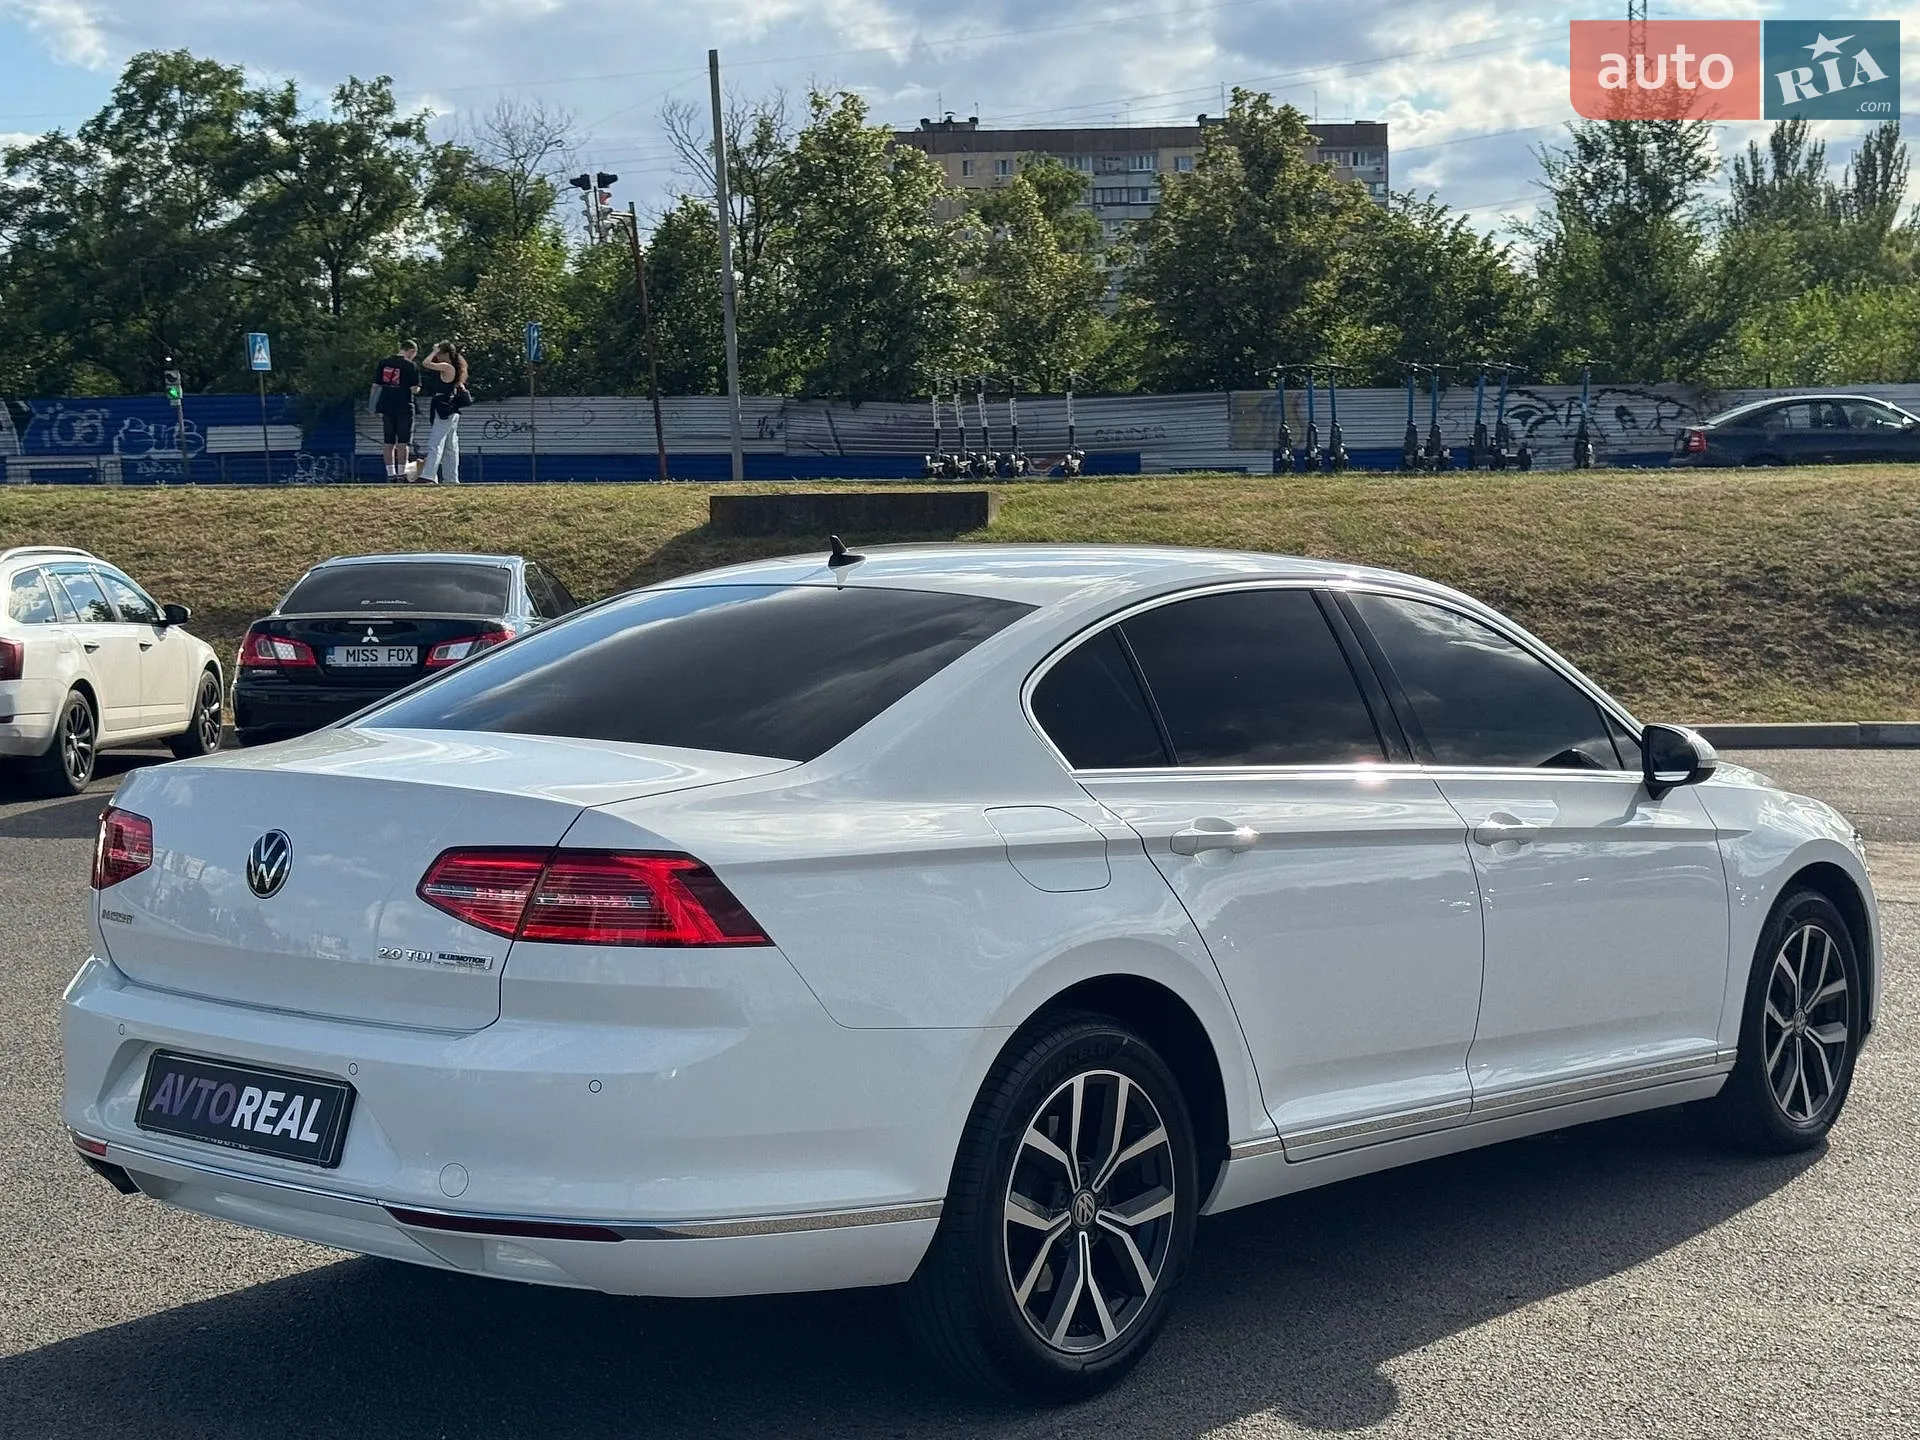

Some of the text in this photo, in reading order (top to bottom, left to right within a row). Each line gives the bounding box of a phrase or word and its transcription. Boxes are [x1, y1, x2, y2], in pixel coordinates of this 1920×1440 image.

[346, 649, 378, 662] MISS
[388, 649, 414, 662] FOX
[405, 949, 432, 963] TDI
[148, 1072, 322, 1143] AVTOREAL
